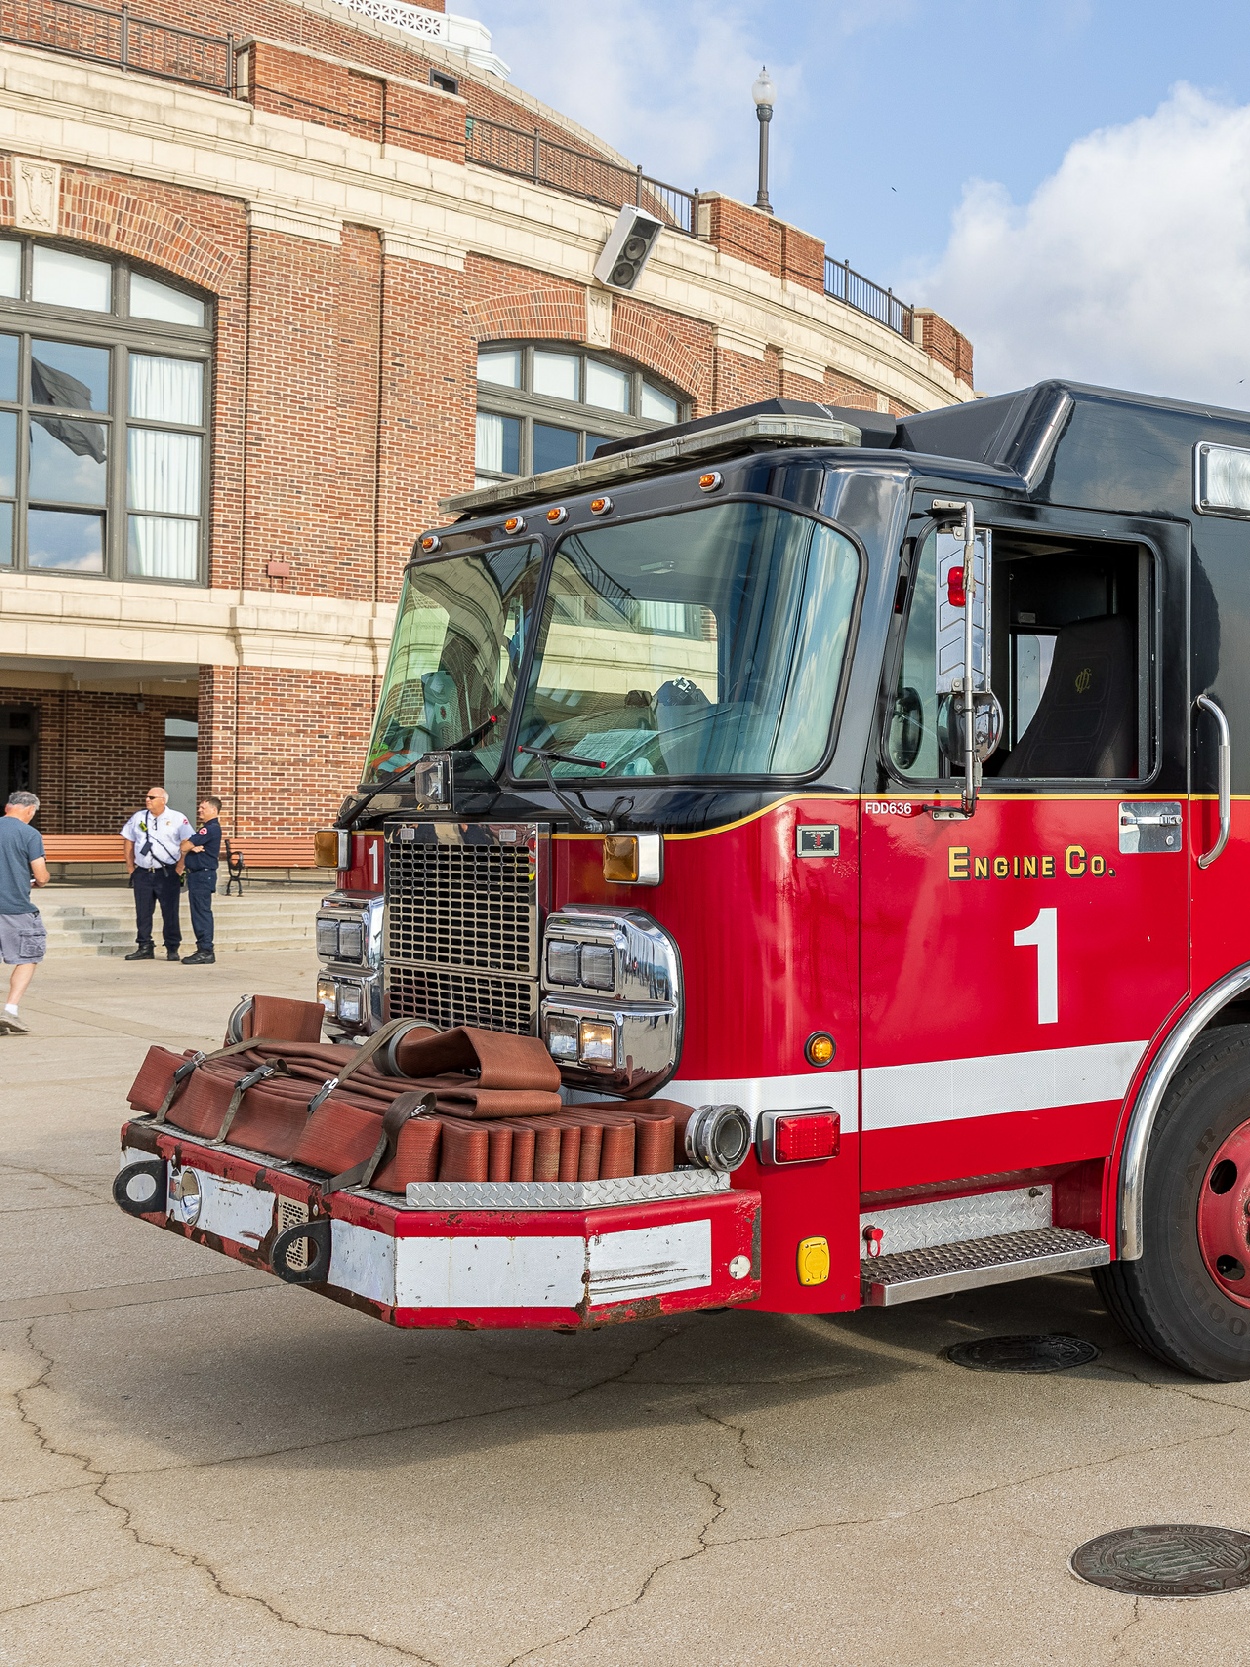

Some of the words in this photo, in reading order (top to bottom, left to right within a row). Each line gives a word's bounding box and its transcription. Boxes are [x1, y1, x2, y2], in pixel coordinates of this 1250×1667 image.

[865, 802, 912, 815] FDD636
[368, 839, 378, 884] 1
[948, 846, 1056, 881] ENGINE
[1065, 844, 1116, 878] CO.
[1014, 907, 1058, 1025] 1
